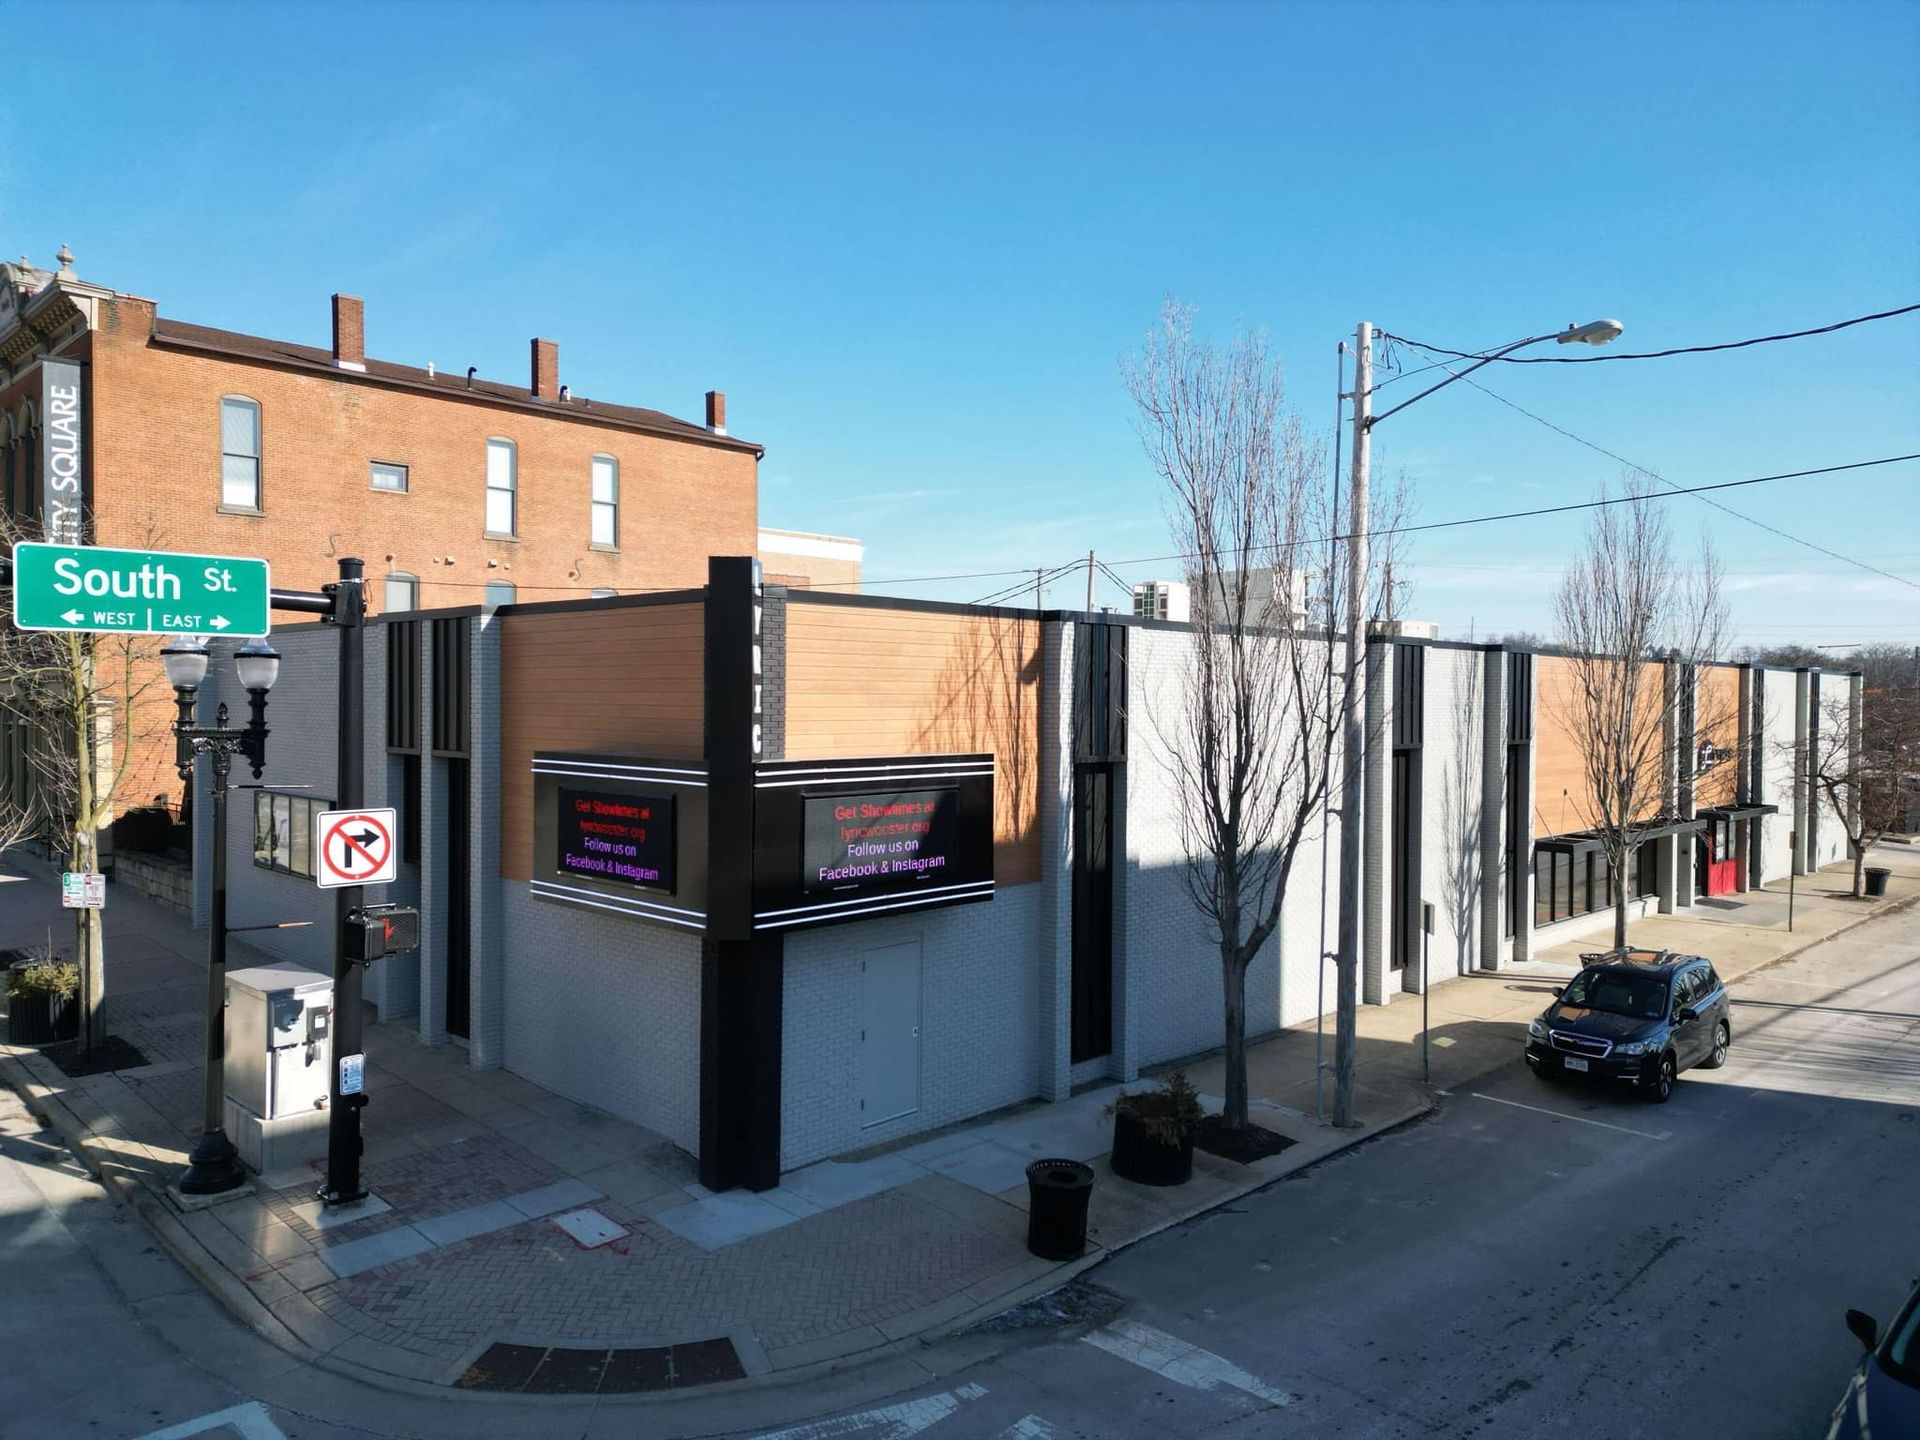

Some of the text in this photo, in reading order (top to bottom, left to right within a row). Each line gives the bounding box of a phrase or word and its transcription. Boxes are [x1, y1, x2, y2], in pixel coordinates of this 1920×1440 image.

[50, 385, 78, 493] SQUARE
[53, 557, 238, 600] South St.
[93, 611, 202, 628] WEST EAST
[752, 562, 762, 754] LYRIC
[576, 799, 591, 813] Get
[834, 801, 936, 820] Get Showtimes at
[584, 837, 637, 857] Follow us on
[848, 839, 919, 857] Follow us on
[566, 853, 658, 881] Facebook & Instagram
[819, 855, 945, 881] Facebook & Instagram
